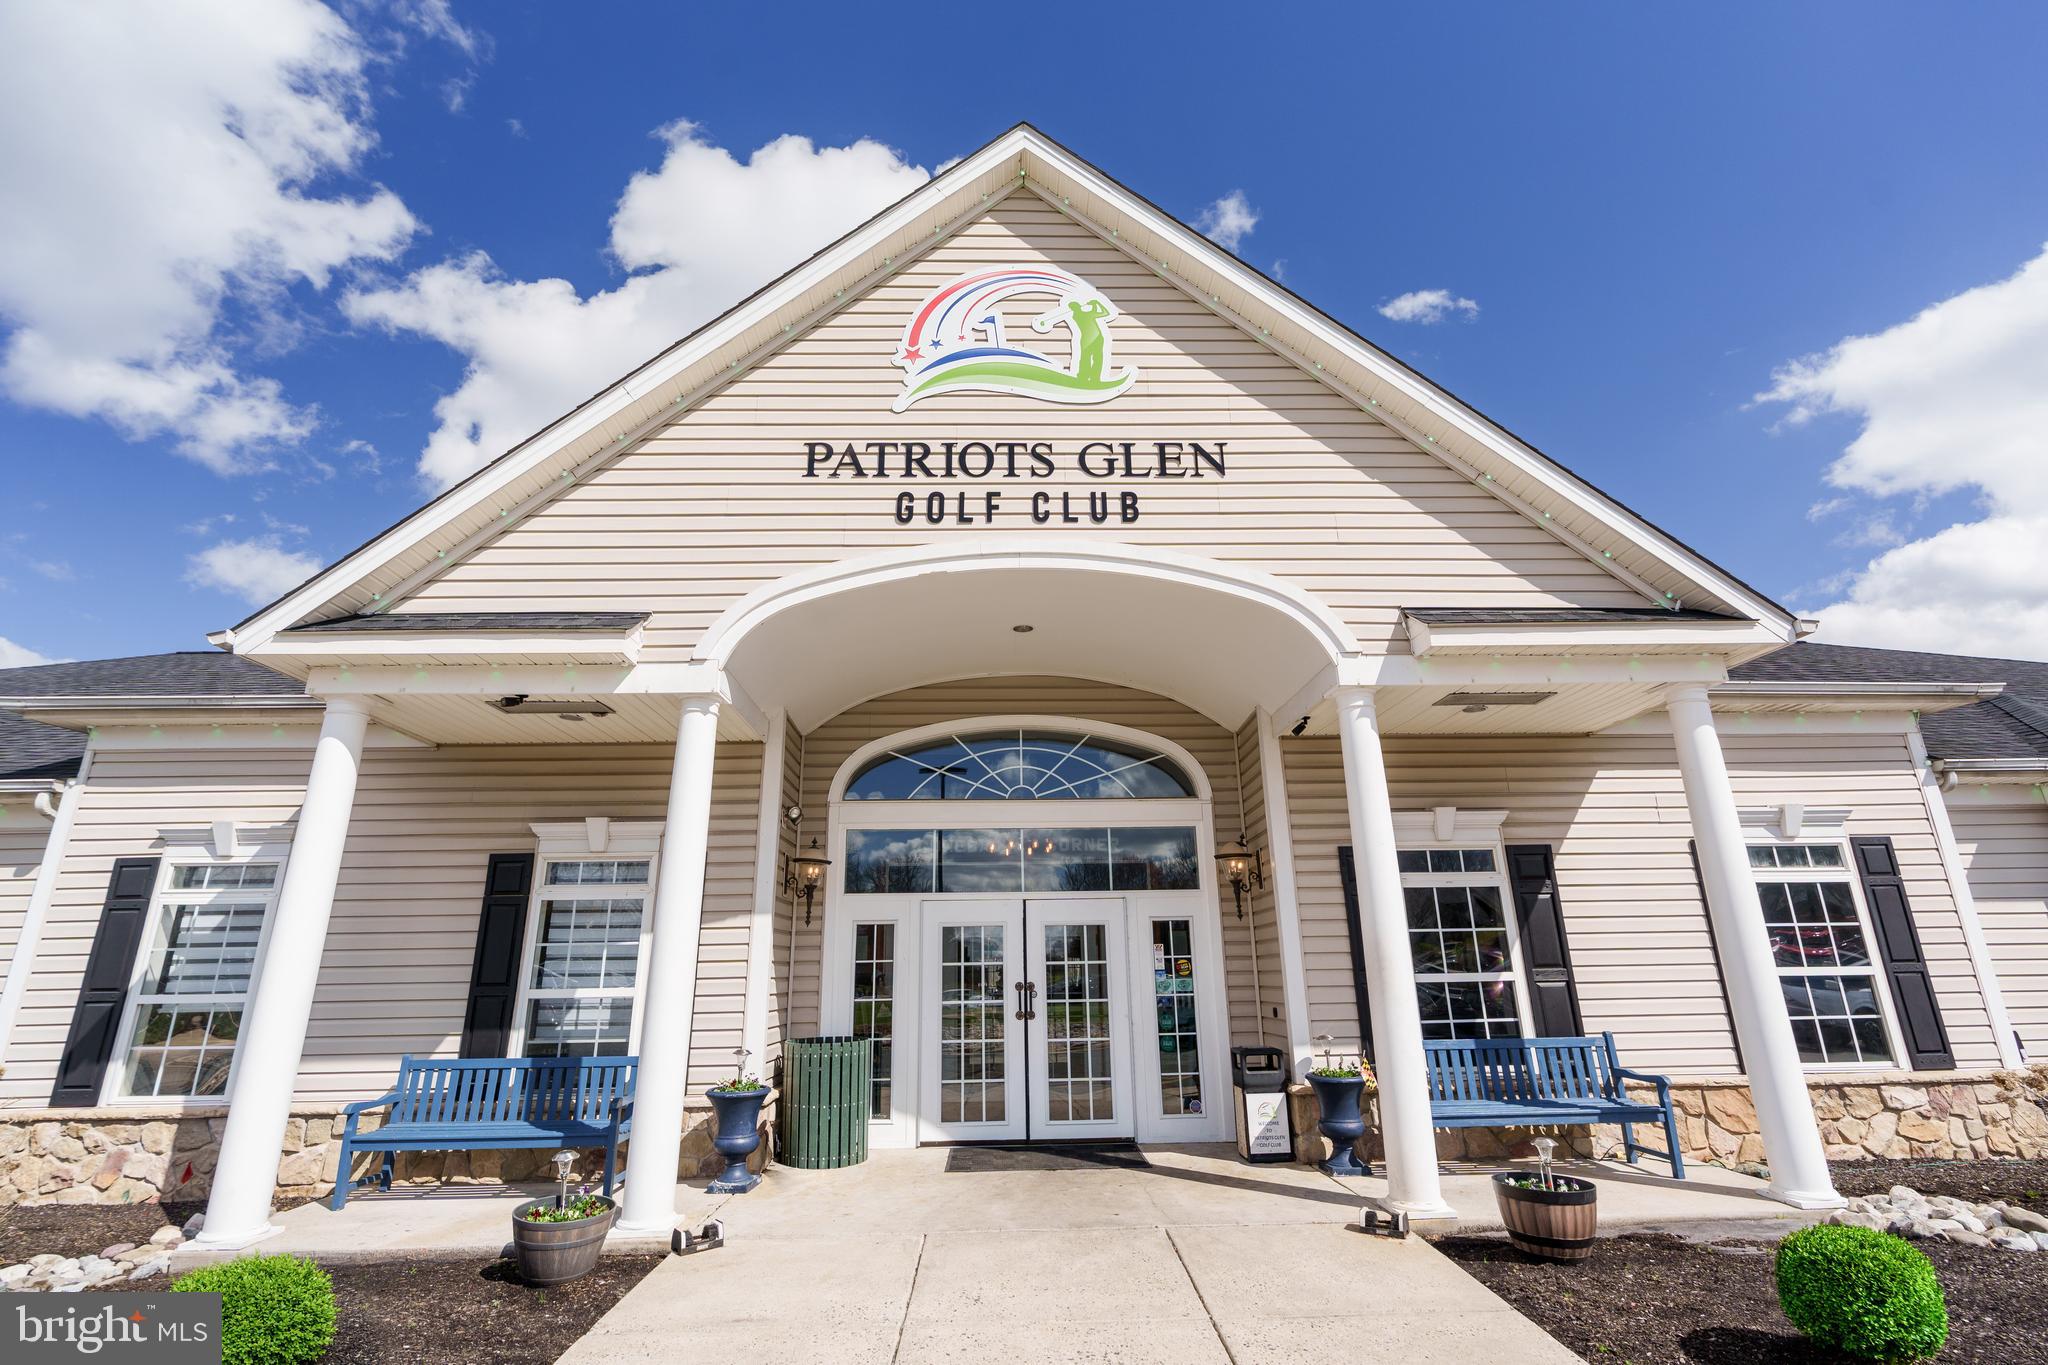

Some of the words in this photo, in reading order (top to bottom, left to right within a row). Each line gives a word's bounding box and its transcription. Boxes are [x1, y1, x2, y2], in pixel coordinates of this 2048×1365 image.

[801, 442, 1055, 478] PATRIOTS
[1078, 442, 1228, 478] GLEN
[896, 491, 1001, 524] GOLF
[1031, 491, 1140, 523] CLUB
